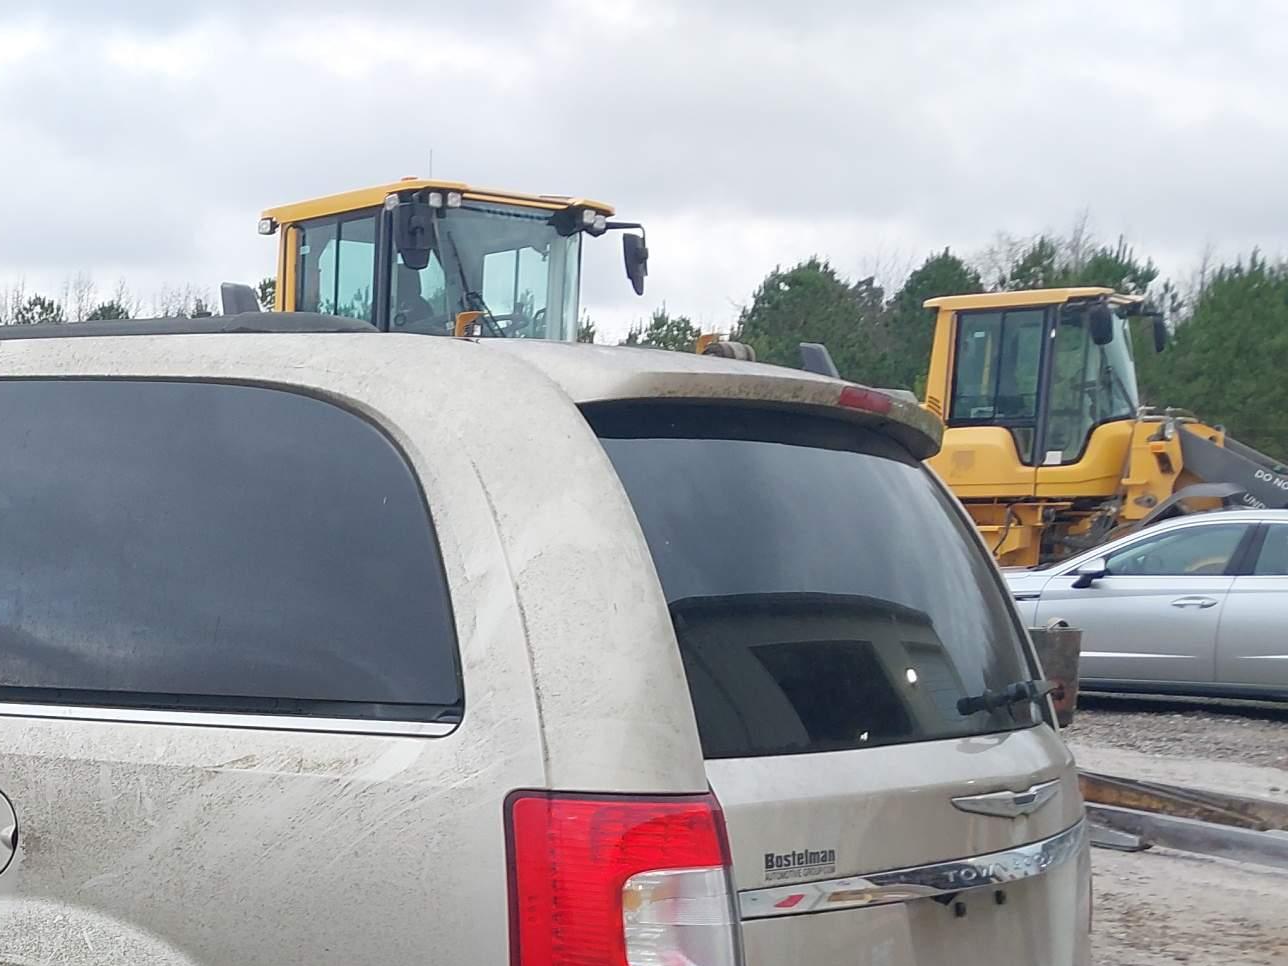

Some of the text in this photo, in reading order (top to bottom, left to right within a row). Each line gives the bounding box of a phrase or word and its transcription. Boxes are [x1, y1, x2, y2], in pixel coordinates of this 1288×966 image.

[1254, 469, 1273, 482] DO
[1243, 493, 1267, 510] UND
[764, 849, 836, 869] Bostelman
